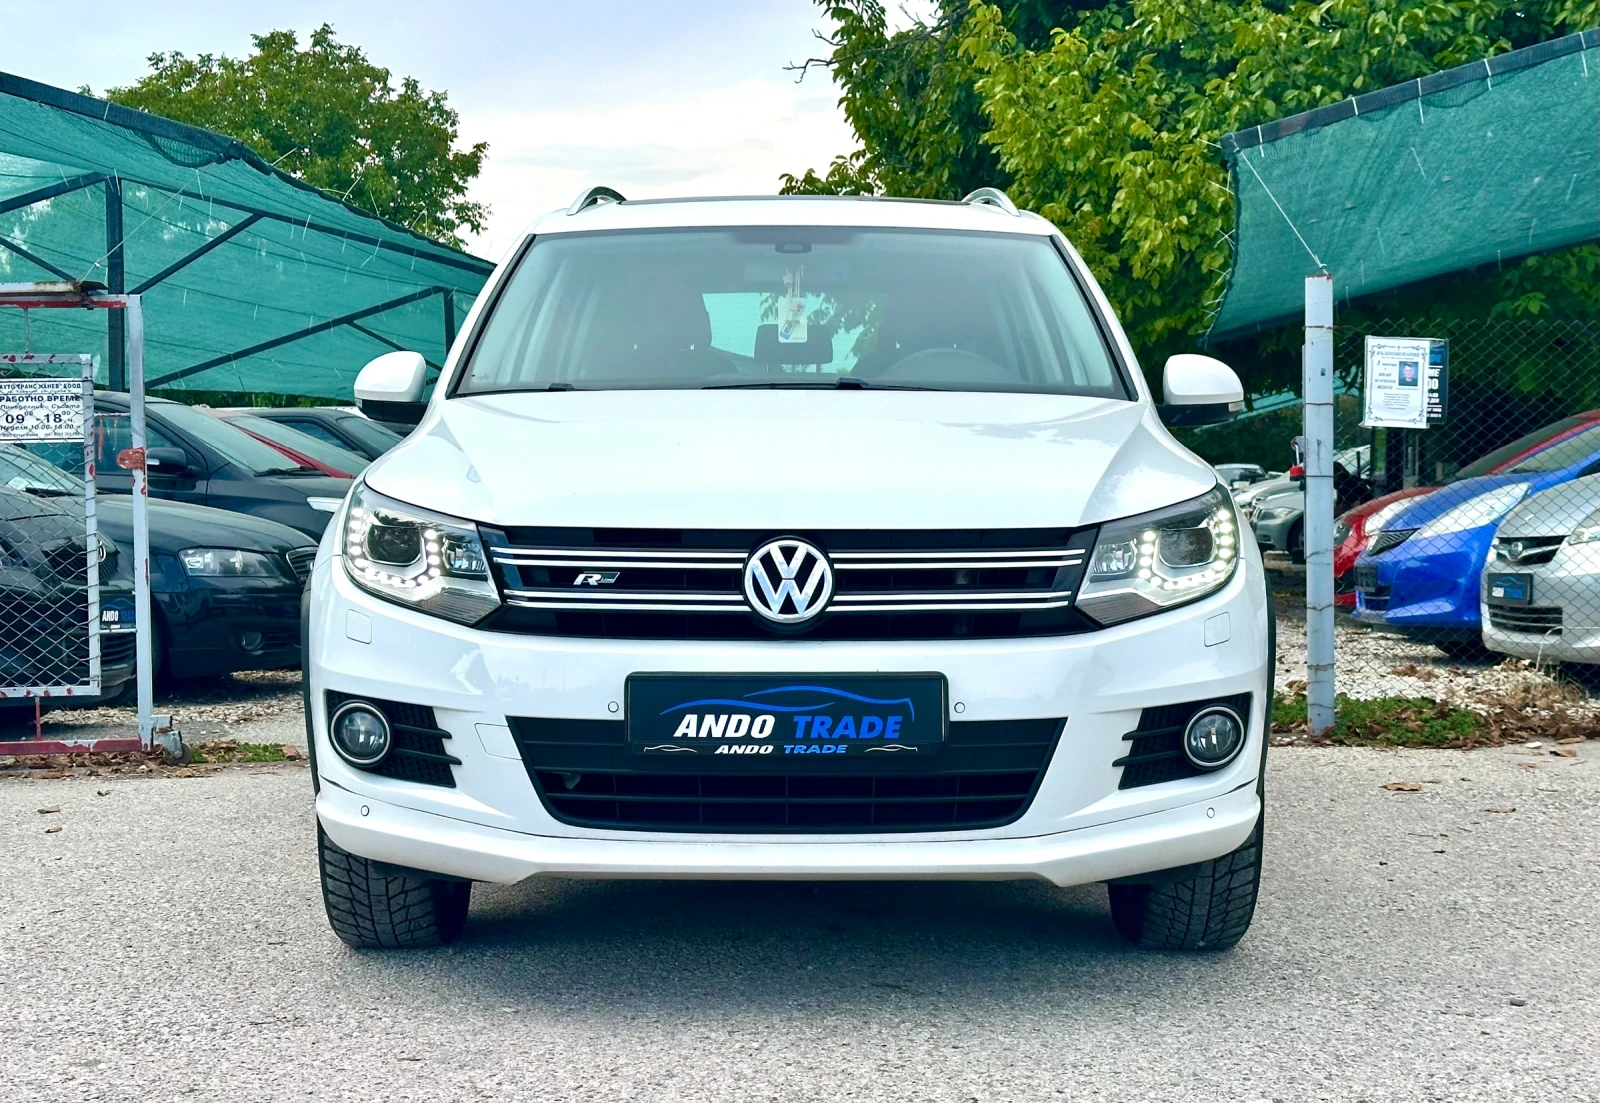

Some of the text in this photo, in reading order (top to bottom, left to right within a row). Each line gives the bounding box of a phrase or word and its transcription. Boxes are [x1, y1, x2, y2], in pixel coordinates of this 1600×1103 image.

[102, 610, 119, 621] ANDO
[673, 714, 903, 739] ANDO TRADE
[714, 744, 848, 754] ANDO TRADE
